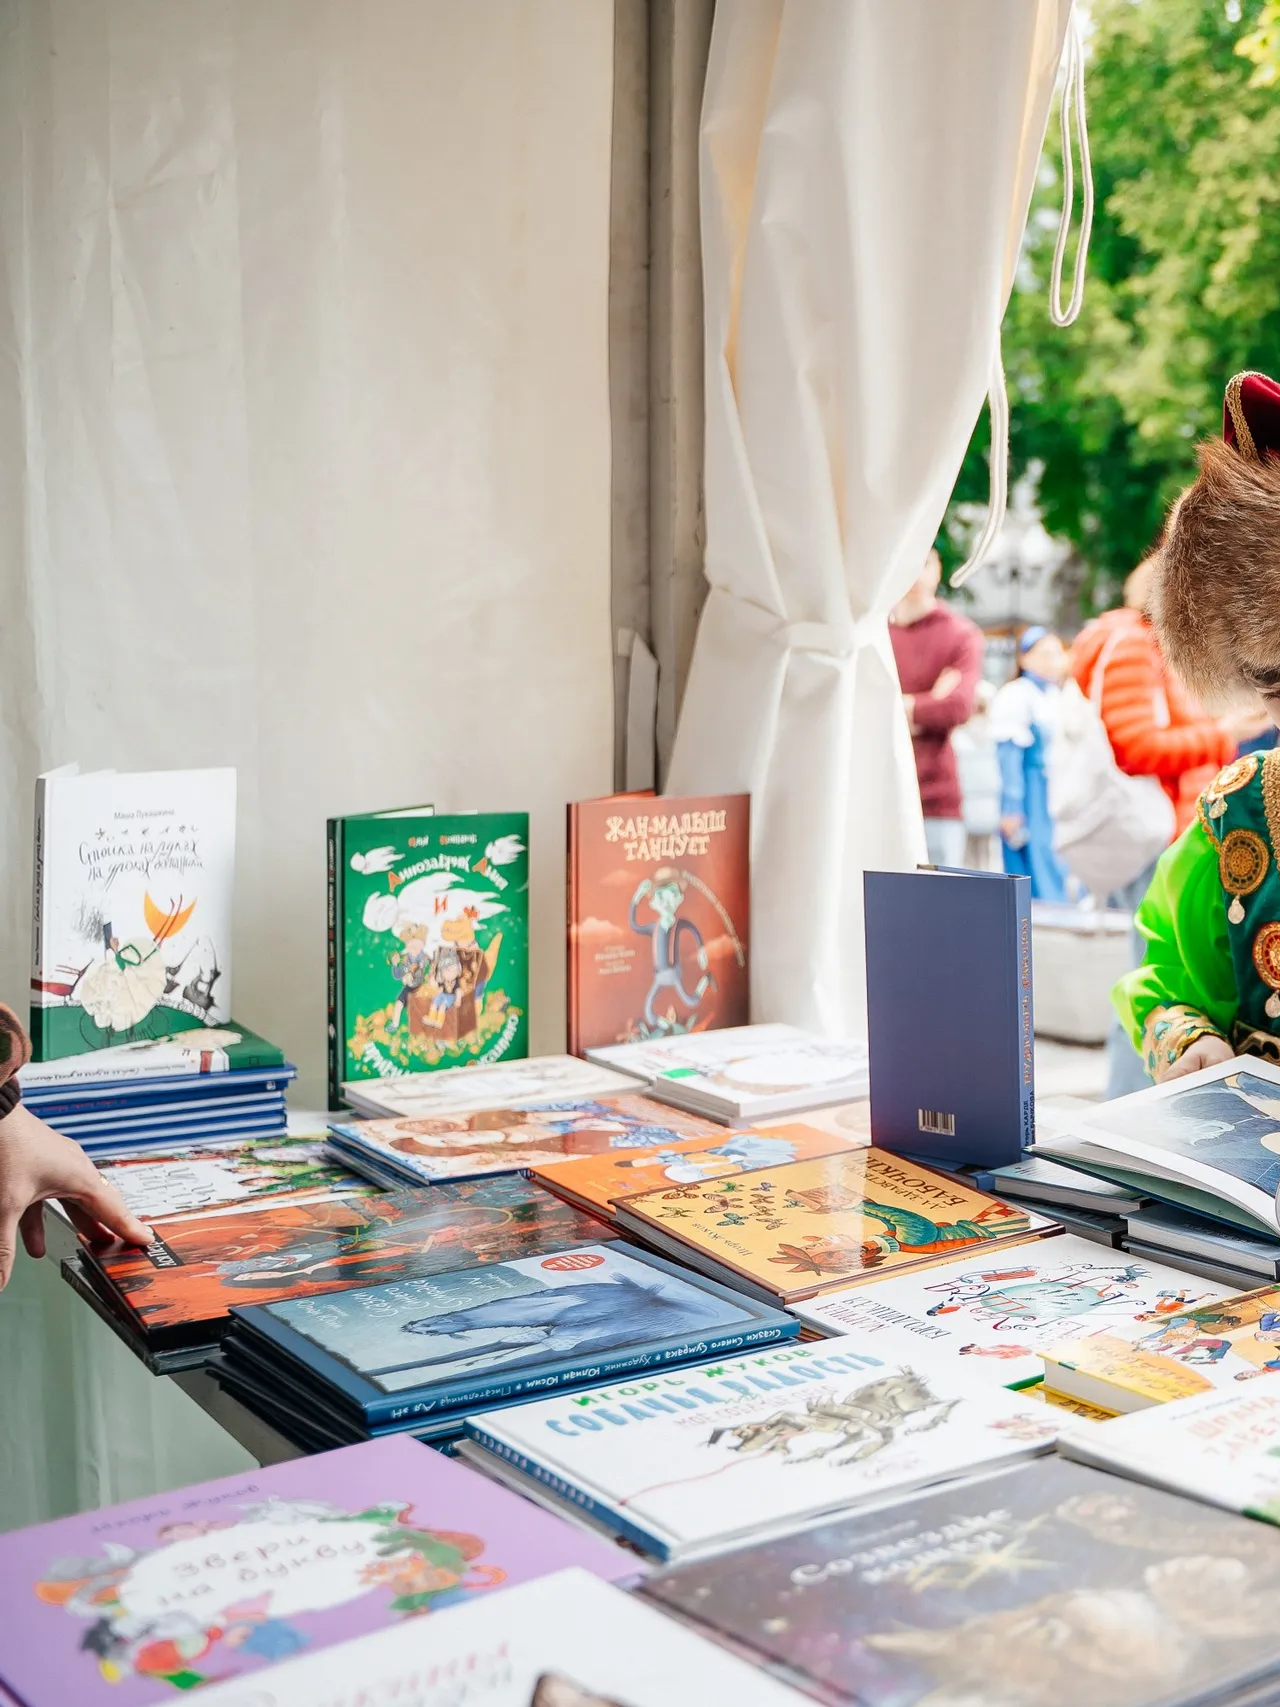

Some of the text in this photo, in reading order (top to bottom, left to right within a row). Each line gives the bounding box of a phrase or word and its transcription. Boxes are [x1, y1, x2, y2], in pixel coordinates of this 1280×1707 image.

[605, 809, 727, 842] ЖАН-МАЛЫШ
[624, 834, 711, 862] ТАНЦУЕТ
[712, 1337, 744, 1349] Синего
[747, 1329, 781, 1342] Сказки
[666, 1342, 708, 1359] Сумрака
[605, 1354, 652, 1372] Художник
[526, 1374, 559, 1388] Юсим
[563, 1366, 600, 1381] Юлиан
[571, 1350, 814, 1407] ИГОРЬ ЖУКОВ
[546, 1353, 885, 1437] СОБАЧЬЯ РАДОСТЬ
